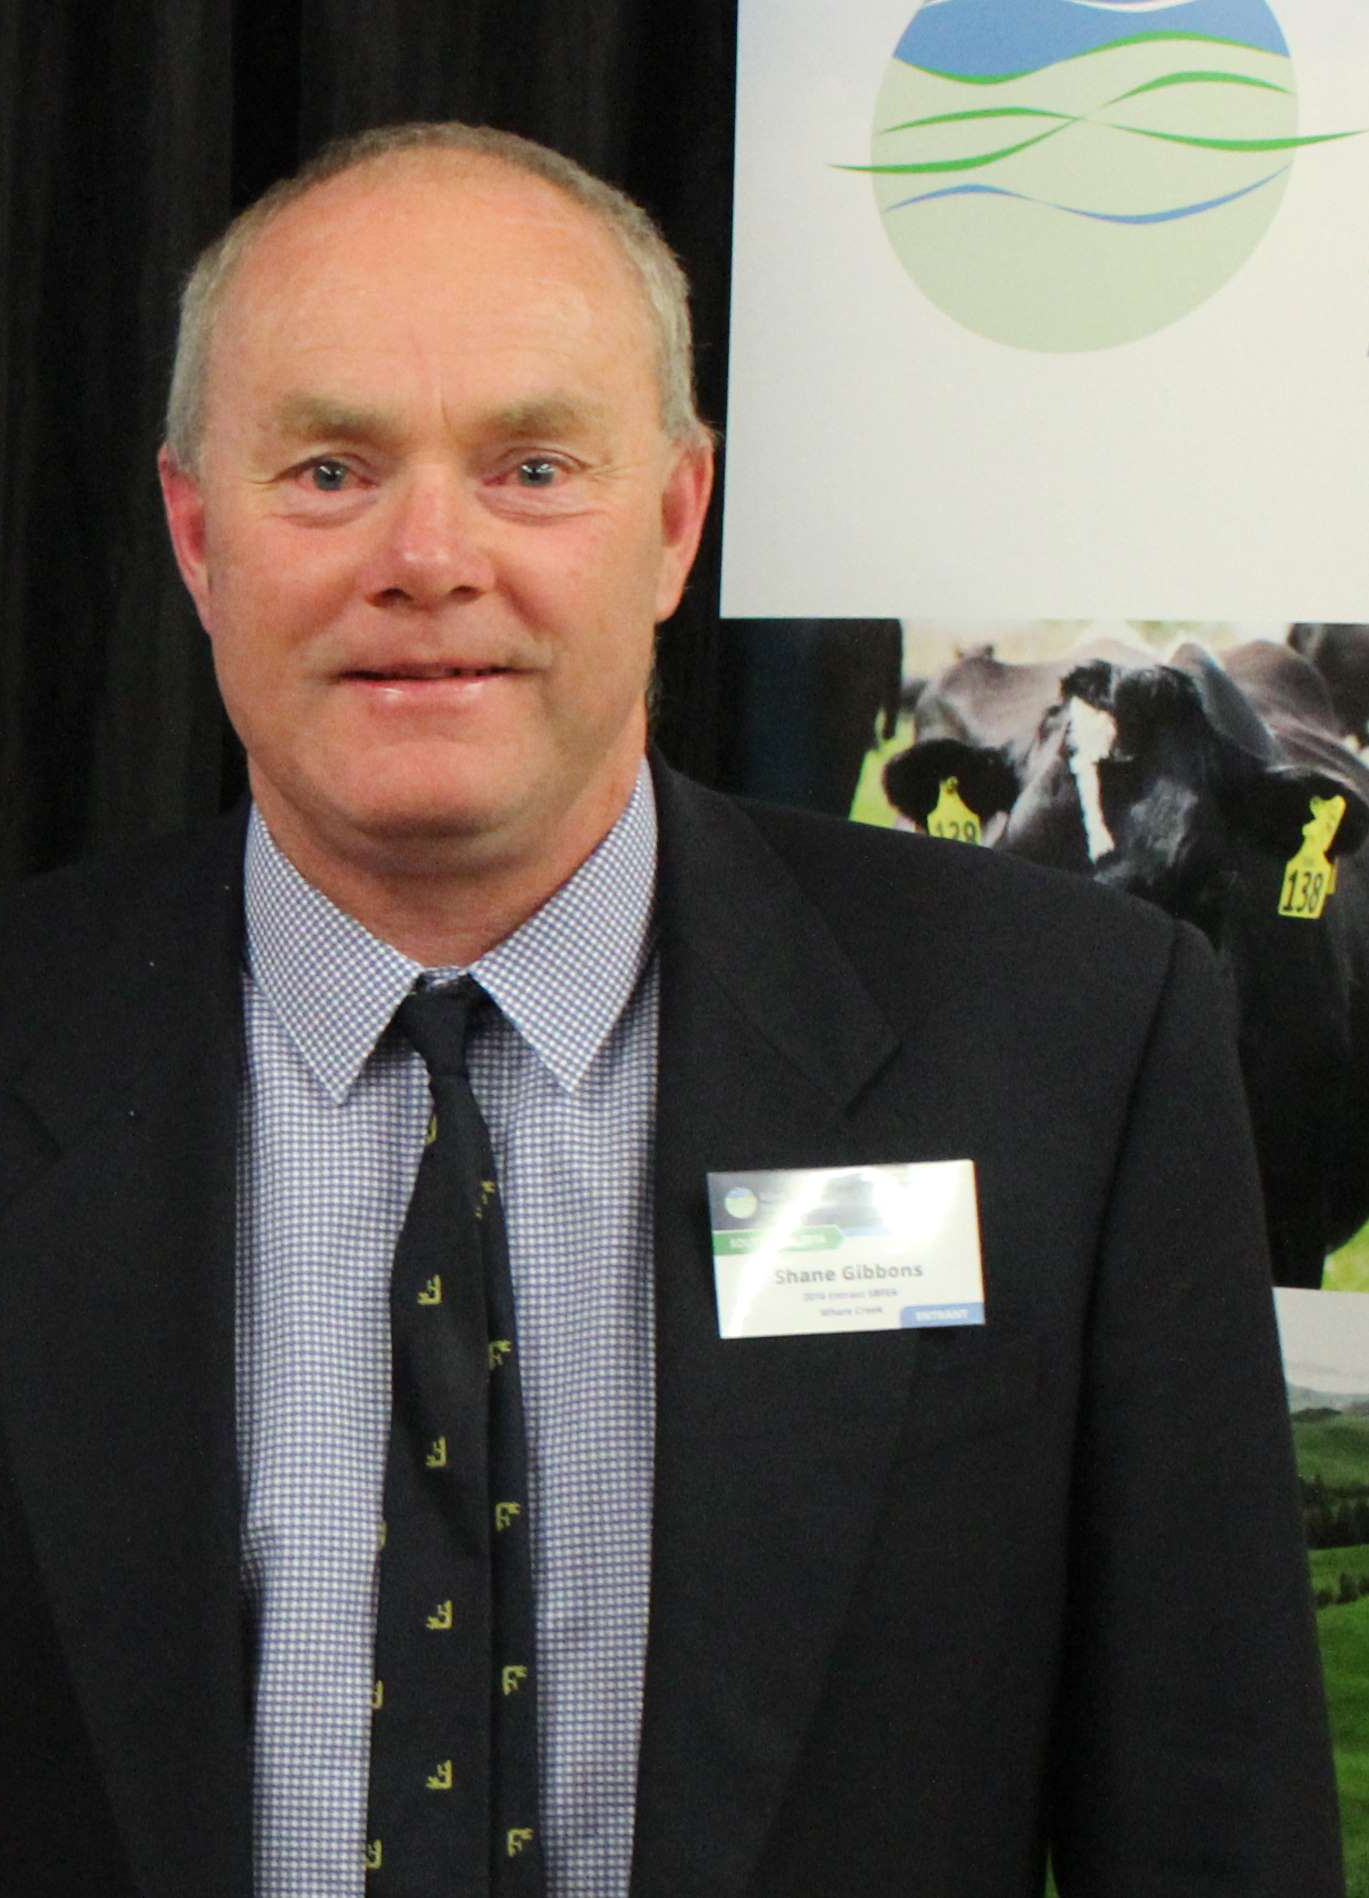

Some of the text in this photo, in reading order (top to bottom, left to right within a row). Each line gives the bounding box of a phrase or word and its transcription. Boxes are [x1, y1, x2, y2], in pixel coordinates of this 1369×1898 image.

[1282, 869, 1324, 914] 138
[775, 1263, 924, 1285] Shane Gibbons
